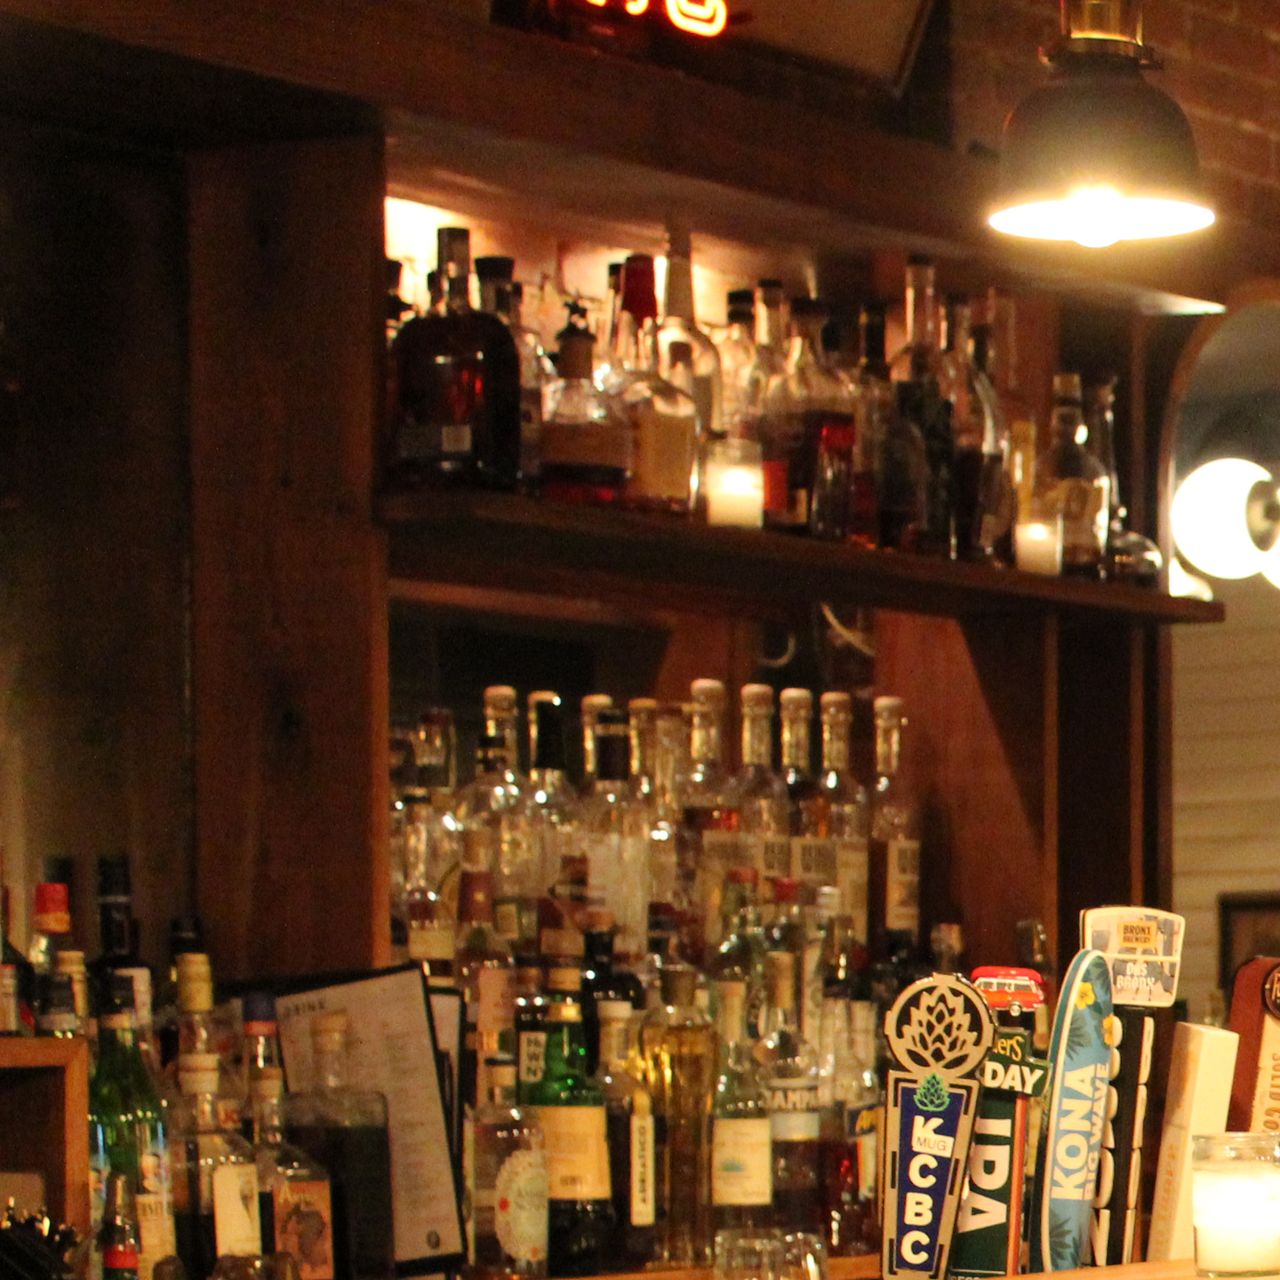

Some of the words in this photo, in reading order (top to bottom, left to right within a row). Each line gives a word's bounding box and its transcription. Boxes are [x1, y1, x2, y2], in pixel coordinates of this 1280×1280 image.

[984, 1061, 1044, 1094] DAY
[1090, 1063, 1109, 1144] WAVE
[916, 1136, 948, 1151] MUG
[1051, 1063, 1096, 1200] KONA
[957, 1117, 1012, 1233] IPA
[1083, 1151, 1099, 1200] BIG
